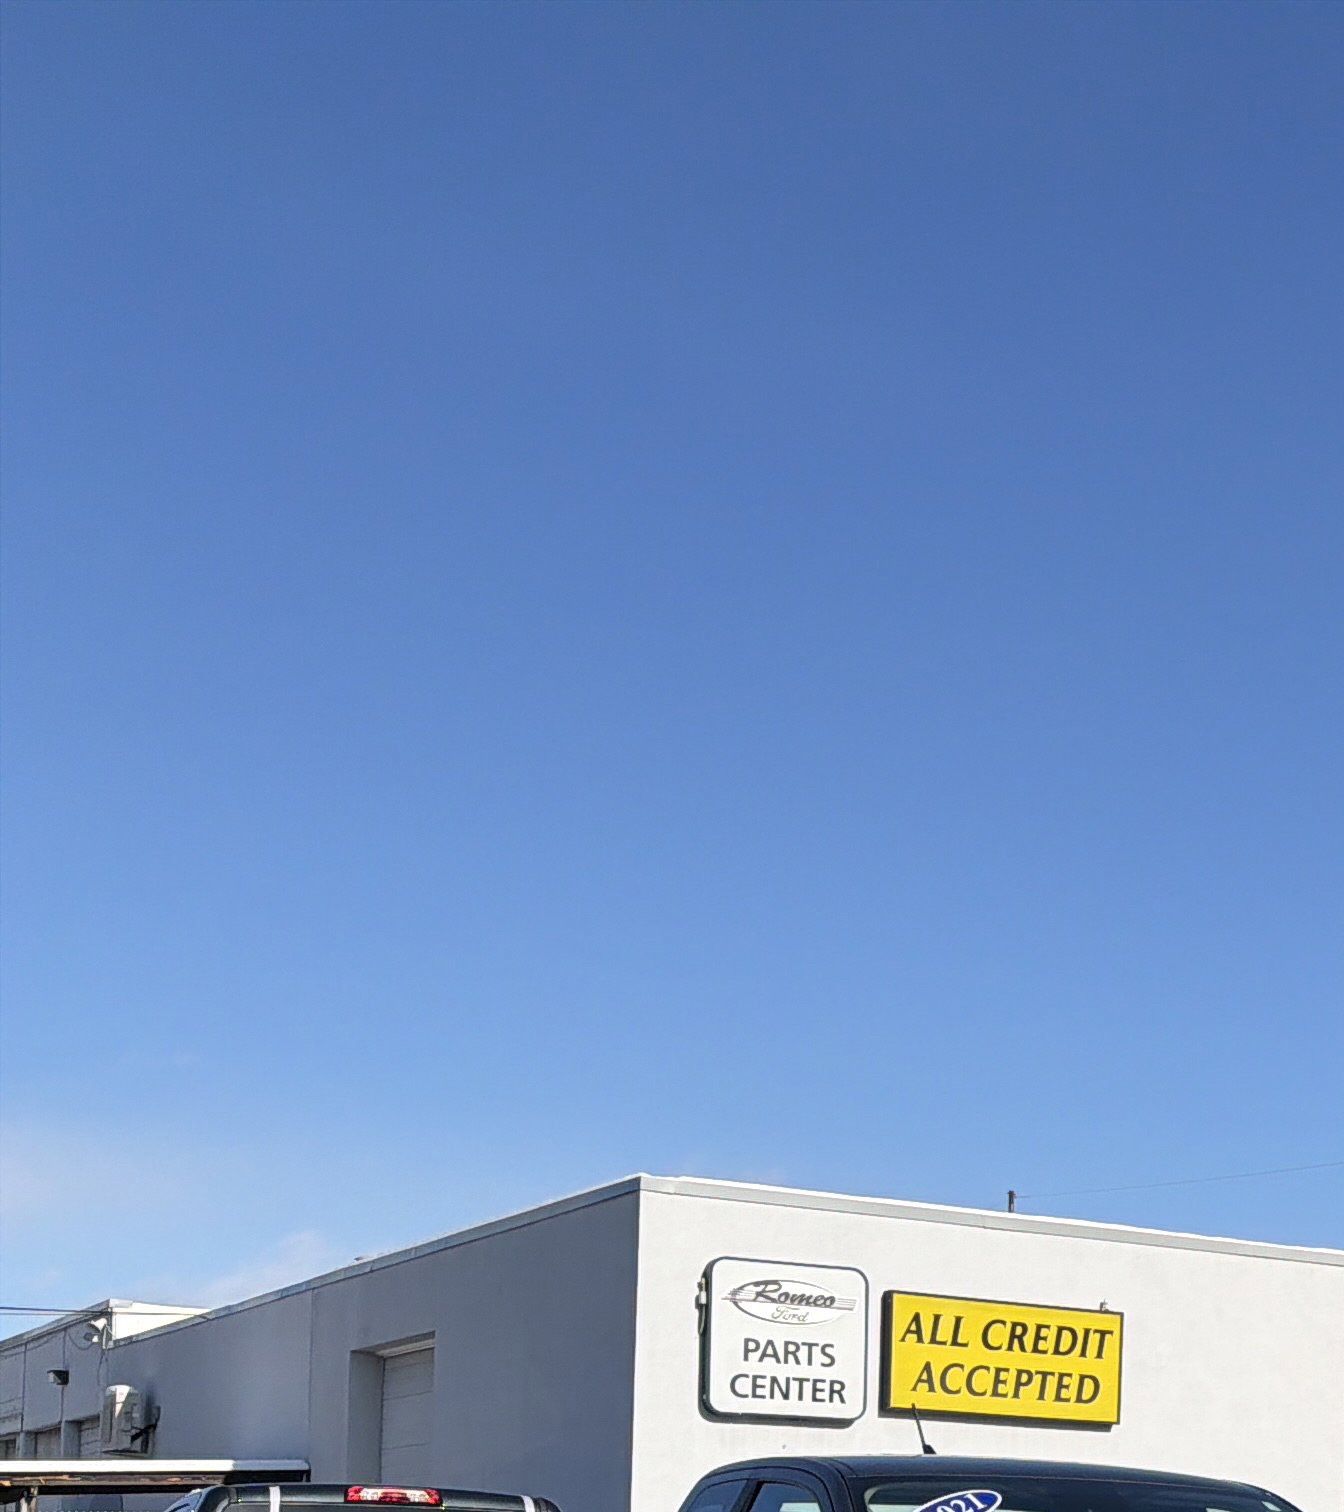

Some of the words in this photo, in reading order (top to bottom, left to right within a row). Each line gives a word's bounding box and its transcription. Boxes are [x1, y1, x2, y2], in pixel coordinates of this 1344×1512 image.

[752, 1280, 836, 1307] Romeo
[771, 1306, 809, 1323] Ford
[899, 1312, 969, 1348] ALL
[981, 1319, 1114, 1360] CREDIT
[743, 1338, 836, 1368] PARTS
[729, 1373, 847, 1405] CENTER
[910, 1361, 1101, 1405] ACCEPTED
